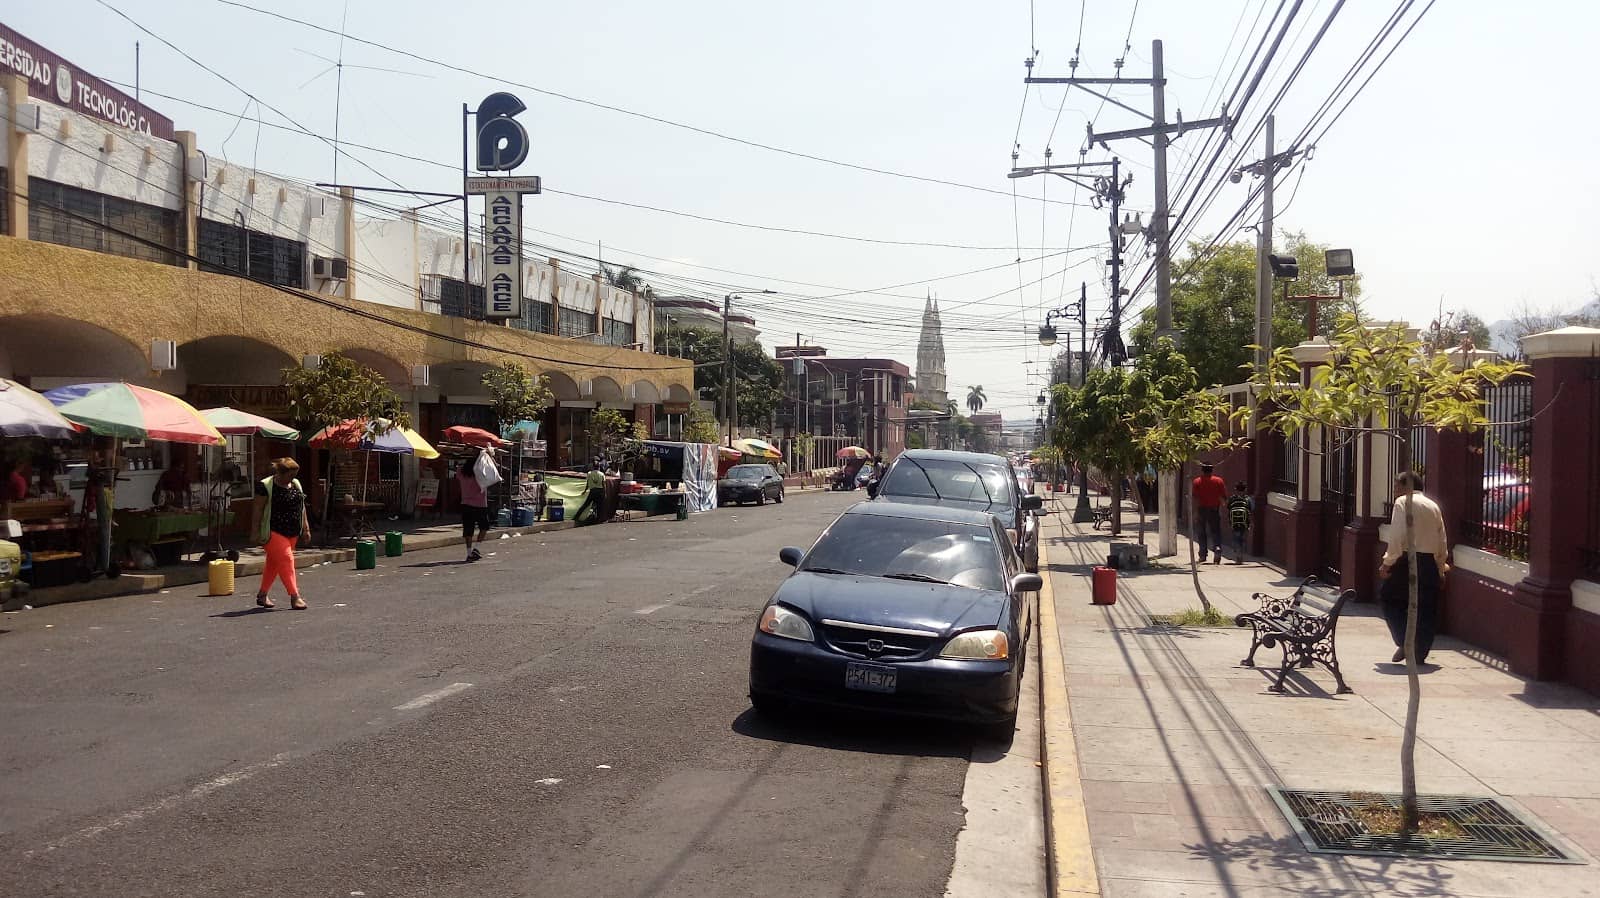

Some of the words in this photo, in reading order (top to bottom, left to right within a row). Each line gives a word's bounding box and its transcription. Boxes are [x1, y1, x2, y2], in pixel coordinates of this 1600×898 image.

[76, 80, 152, 137] TECNOLÓGCA
[490, 195, 513, 265] ARCADAS
[491, 272, 513, 312] ARCE
